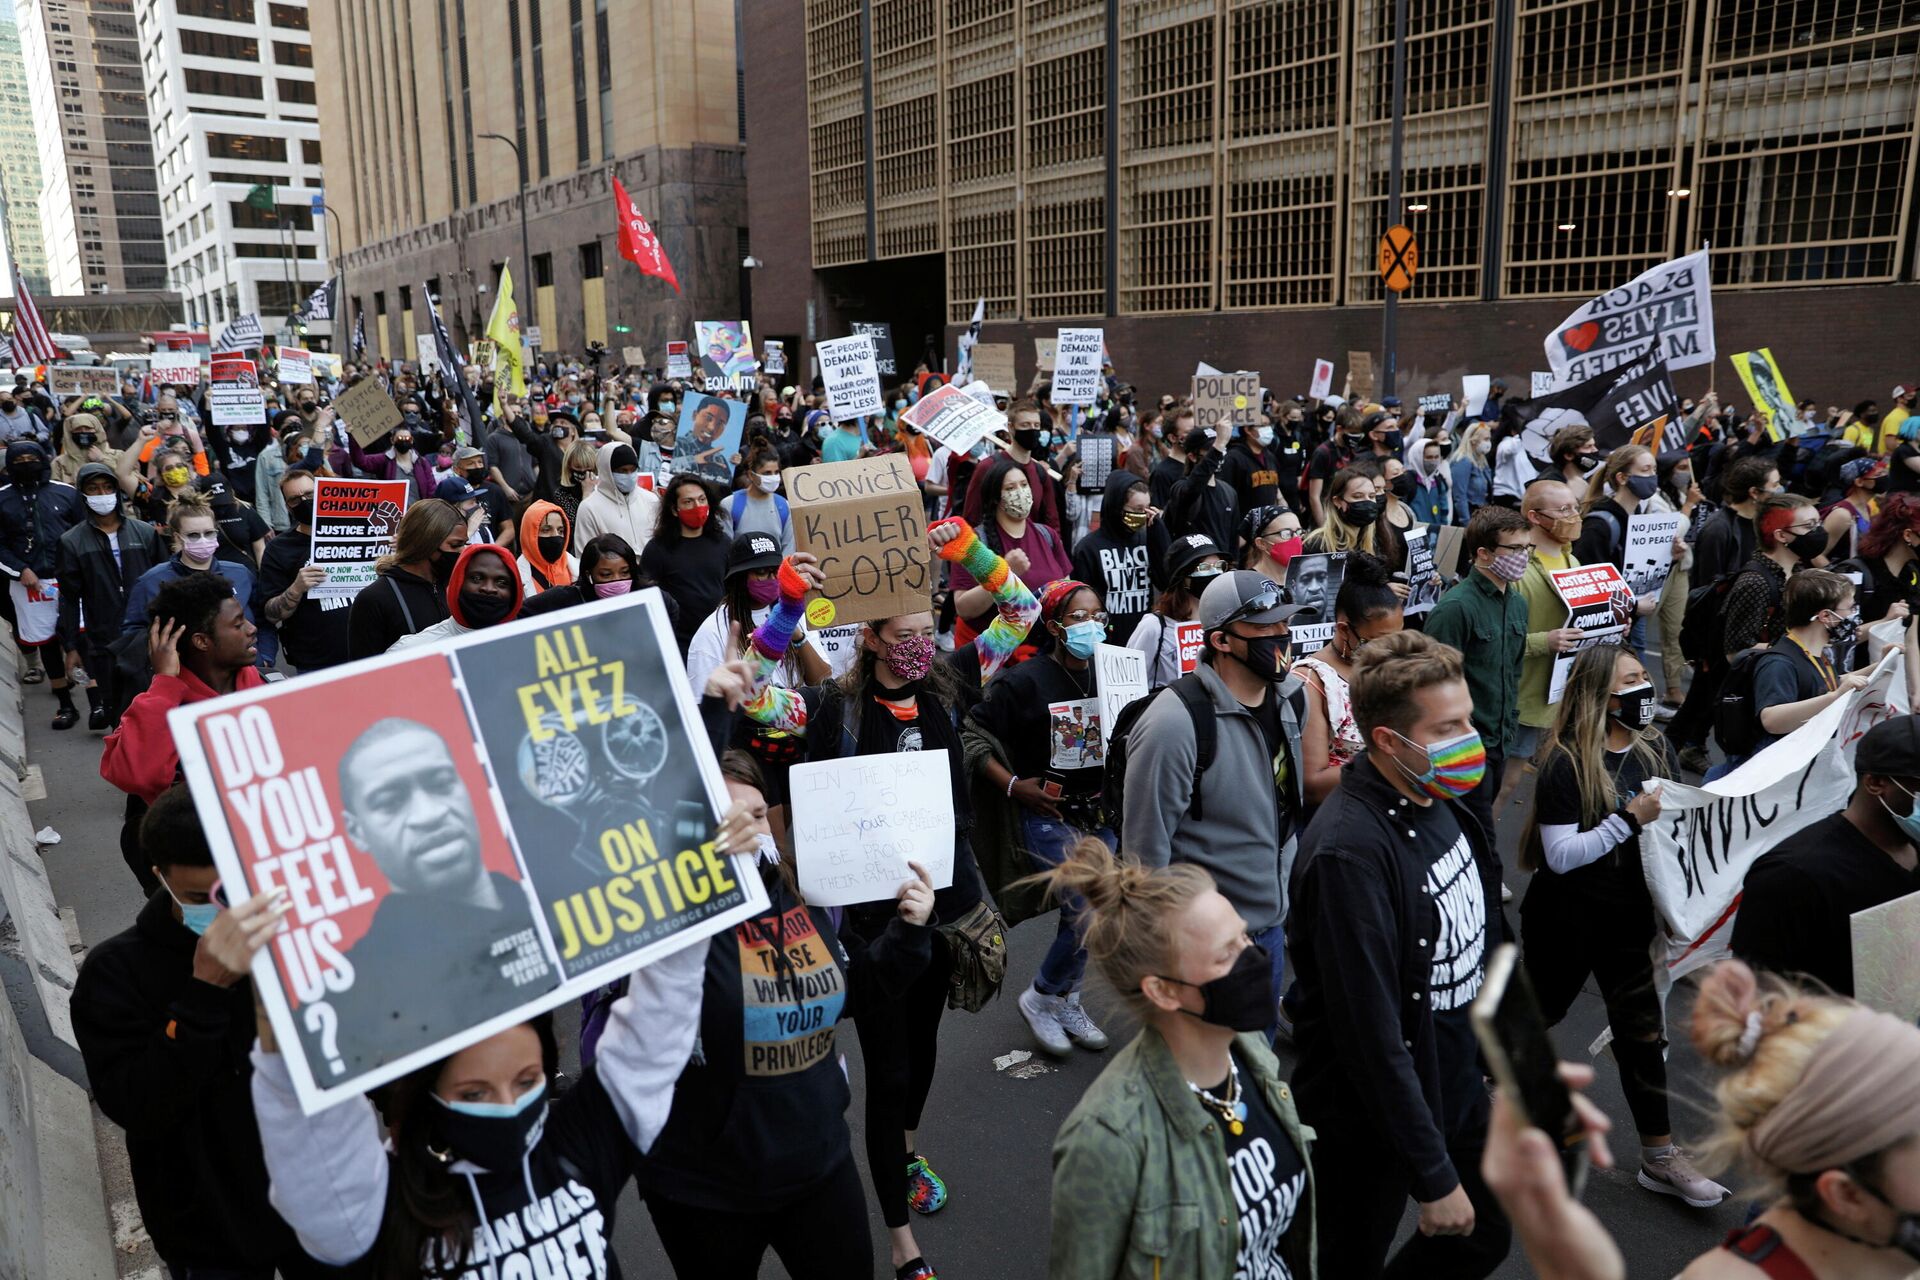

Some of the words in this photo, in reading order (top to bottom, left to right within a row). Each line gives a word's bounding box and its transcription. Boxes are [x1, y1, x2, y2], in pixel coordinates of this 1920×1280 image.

[1383, 249, 1391, 265] R
[1407, 250, 1415, 266] R
[837, 341, 869, 353] PEOPLE
[1074, 334, 1100, 342] PEOPLE
[1061, 344, 1101, 353] DEMAND:
[824, 350, 872, 368] DEMAND:
[1069, 356, 1089, 366] JAIL
[151, 367, 200, 383] BREATHE
[840, 365, 863, 378] JAIL
[705, 375, 756, 391] EQUALITY
[829, 382, 855, 393] KILLER
[1058, 378, 1095, 386] NOTHING
[1073, 387, 1095, 396] LESS!
[1197, 378, 1257, 398] POLICE
[338, 380, 383, 414] JUSTICE
[833, 386, 876, 402] NOTHING
[853, 396, 878, 410] LESS!
[1217, 397, 1234, 407] THE
[351, 401, 387, 429] GEORGE
[321, 486, 380, 499] CONVICT
[319, 500, 380, 512] CHAUVIN
[316, 525, 365, 536] JUSTICE
[367, 525, 389, 536] FOR
[805, 505, 919, 550] KILLER
[1631, 524, 1646, 533] NO
[1646, 521, 1679, 534] JUSTICE
[1631, 537, 1647, 546] NO
[1648, 535, 1674, 545] PEACE
[315, 546, 362, 560] GEORGE
[330, 575, 363, 583] CONTROL
[364, 574, 378, 582] OVE
[336, 566, 353, 574] NOW
[819, 546, 926, 600] COPS
[1558, 573, 1594, 588] JUSTICE
[1591, 570, 1611, 581] FOR
[1562, 583, 1600, 600] GEORGE
[1597, 580, 1626, 594] FLOYD
[1105, 591, 1151, 615] MATTE
[1573, 610, 1614, 629] CONVICT
[534, 624, 599, 679] ALL
[827, 640, 839, 652] to
[1305, 642, 1322, 652] FOR
[516, 660, 638, 744] EYEZ
[204, 704, 285, 790] DO
[804, 769, 841, 792] IN
[852, 766, 882, 785] THE
[889, 760, 926, 788] YEAR
[843, 791, 865, 813] 2
[880, 786, 898, 807] 5
[228, 765, 336, 860] YOU
[801, 823, 850, 843] WILL
[599, 818, 660, 876] ON
[828, 850, 854, 866] BE
[863, 838, 915, 859] PROUD
[865, 861, 883, 873] OF
[253, 835, 375, 933] FEEL
[813, 872, 860, 891] THEIR
[552, 841, 736, 960] JUSTICE
[1432, 856, 1486, 962] LYNCH
[567, 945, 622, 974] JUSTICE
[625, 931, 652, 949] FOR
[653, 907, 704, 937] GEORGE
[704, 890, 742, 915] FLOYD
[489, 927, 538, 957] JUSTICE
[517, 941, 542, 957] FOR
[277, 918, 356, 1005] US
[501, 953, 545, 979] GEORGE
[512, 962, 549, 988] FLOYD
[776, 1004, 825, 1037] YOUR
[304, 1000, 347, 1077] ?
[752, 1028, 835, 1072] PRIVILEGE
[1227, 1136, 1277, 1214] TOP
[522, 1178, 597, 1239] WAS
